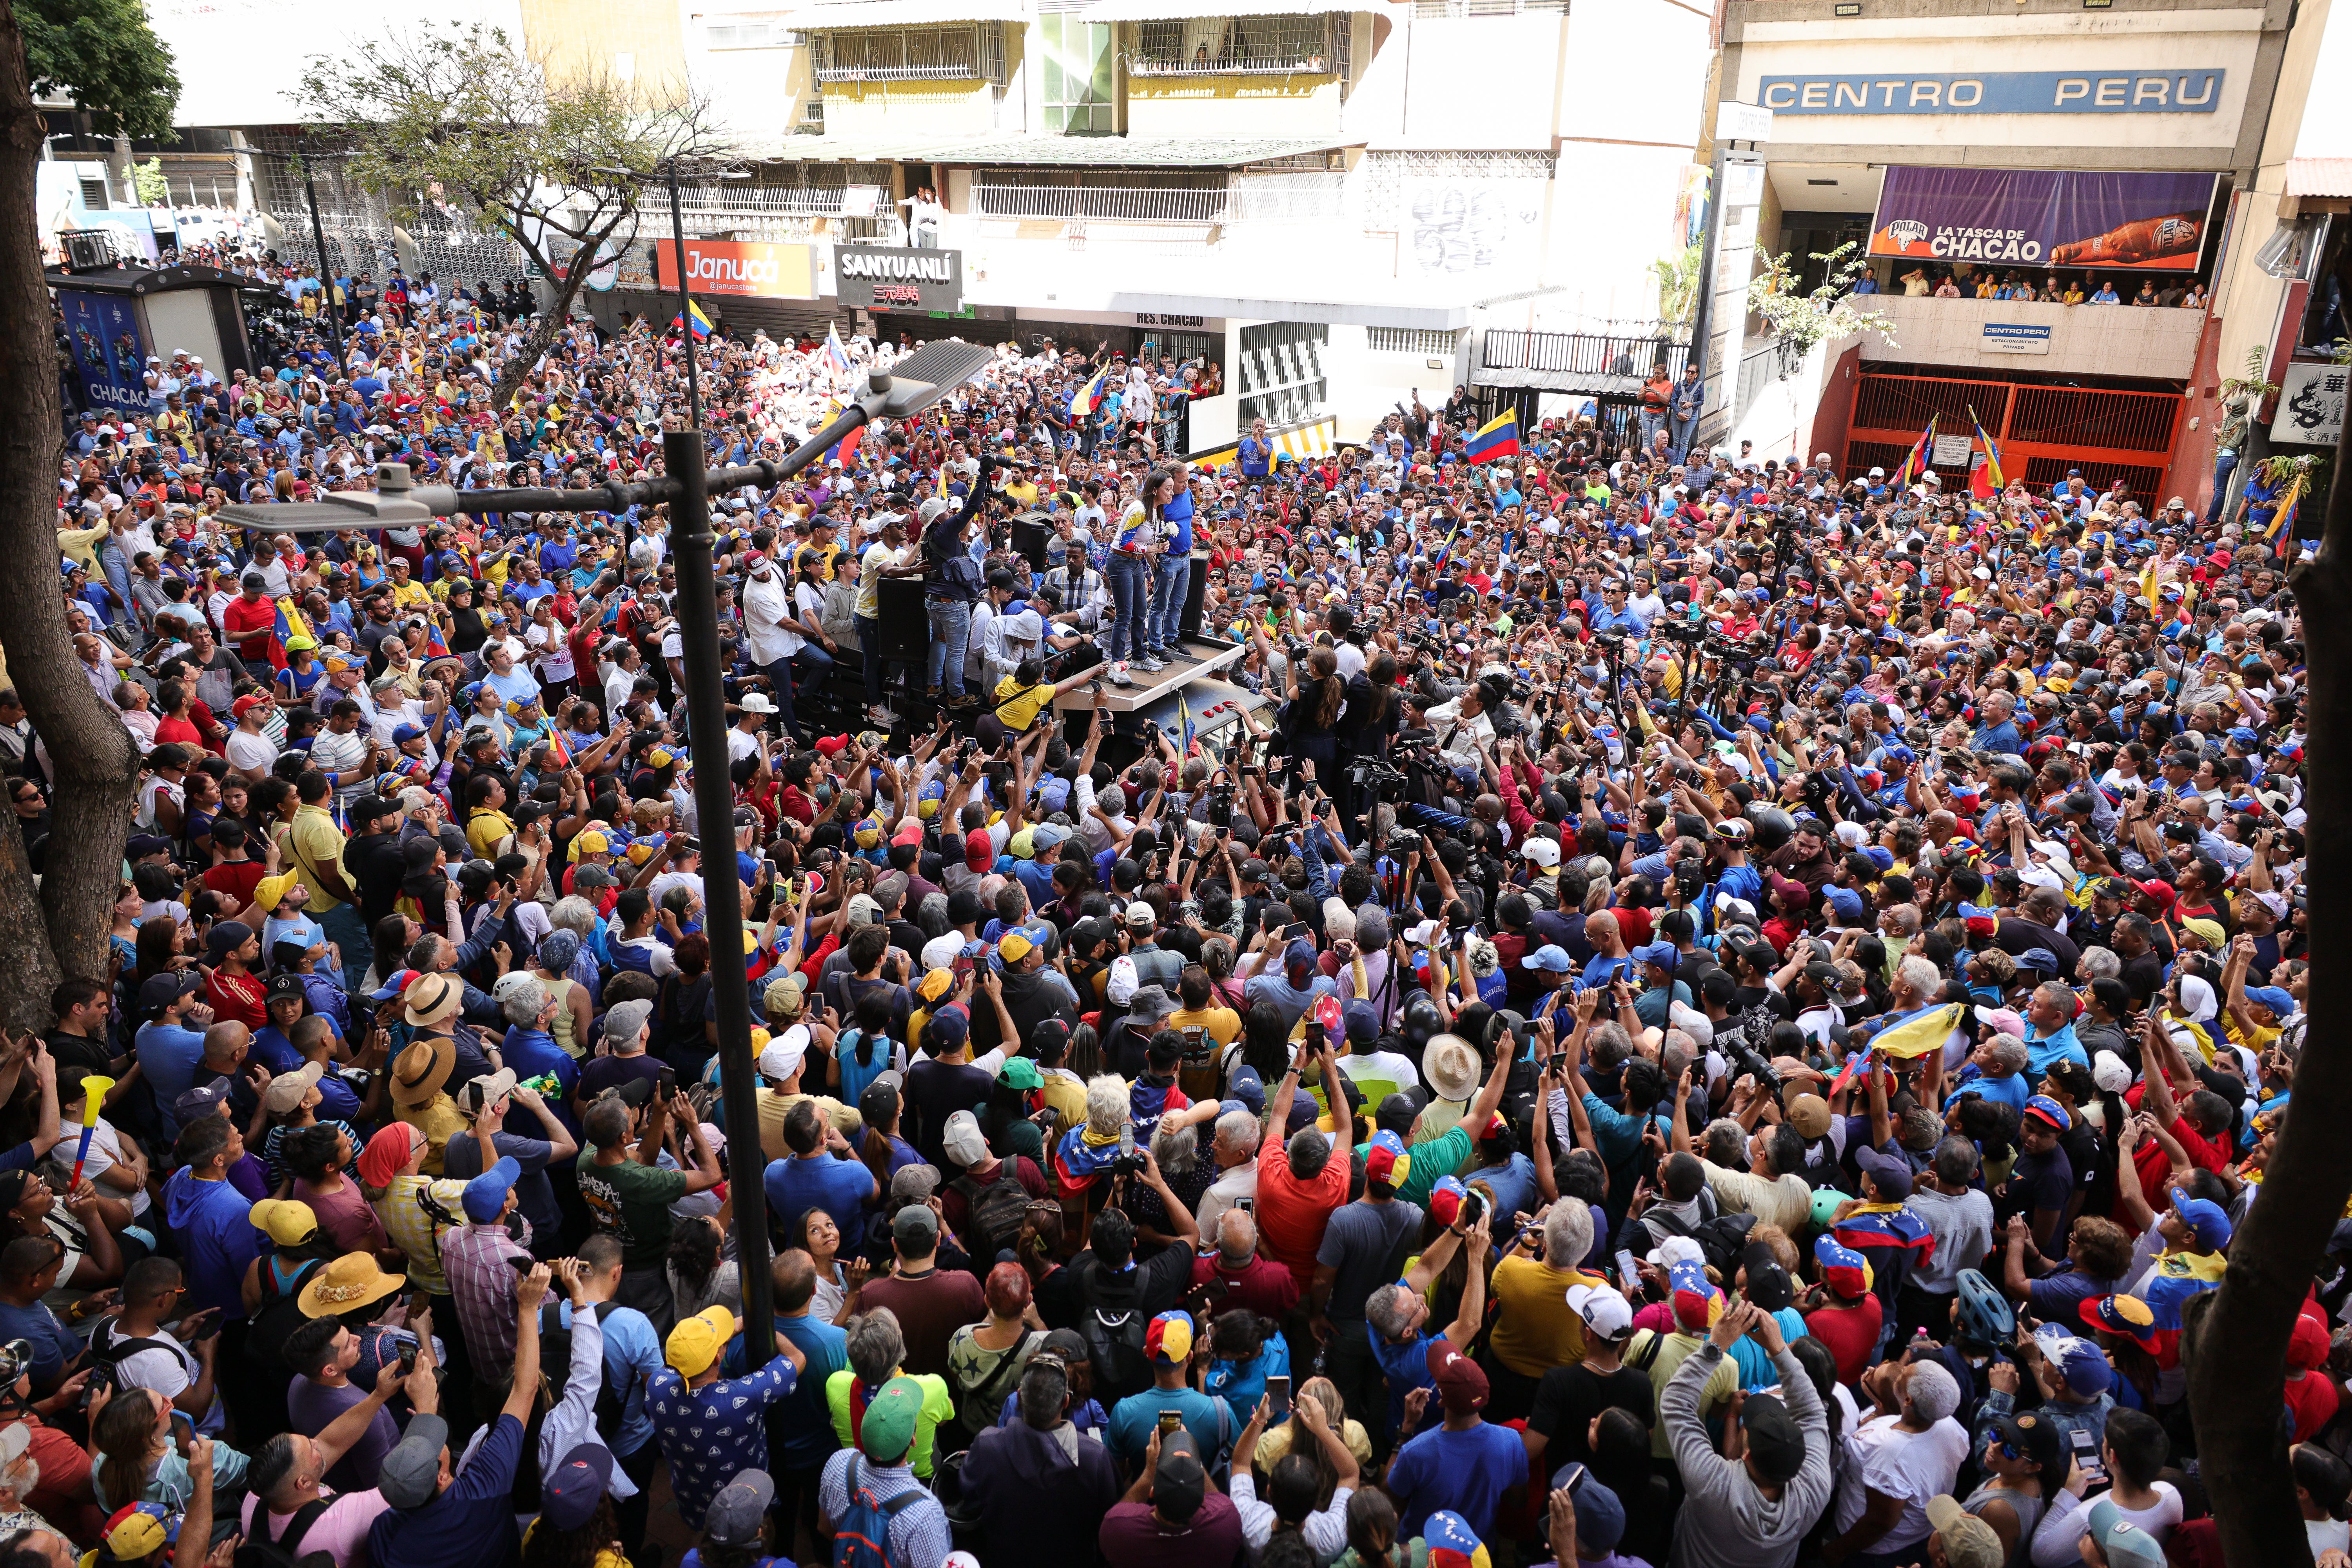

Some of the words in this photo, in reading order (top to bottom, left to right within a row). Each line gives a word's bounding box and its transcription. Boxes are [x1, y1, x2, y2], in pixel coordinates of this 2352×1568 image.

[1764, 79, 1983, 108] CENTRO
[2053, 76, 2215, 106] PERU
[1891, 220, 1925, 236] POLAR
[1936, 226, 1951, 236] LA
[1955, 227, 2004, 240] TASCA
[2005, 230, 2025, 240] DE
[549, 240, 577, 249] Condimentos
[1930, 236, 2041, 261] CHACAO
[554, 250, 574, 259] Especias
[842, 252, 951, 280] SANYUANLÍ
[709, 281, 757, 292] @janucastore
[873, 285, 919, 301] 三元基站
[1137, 313, 1158, 324] RES.
[752, 556, 765, 567] OBEY
